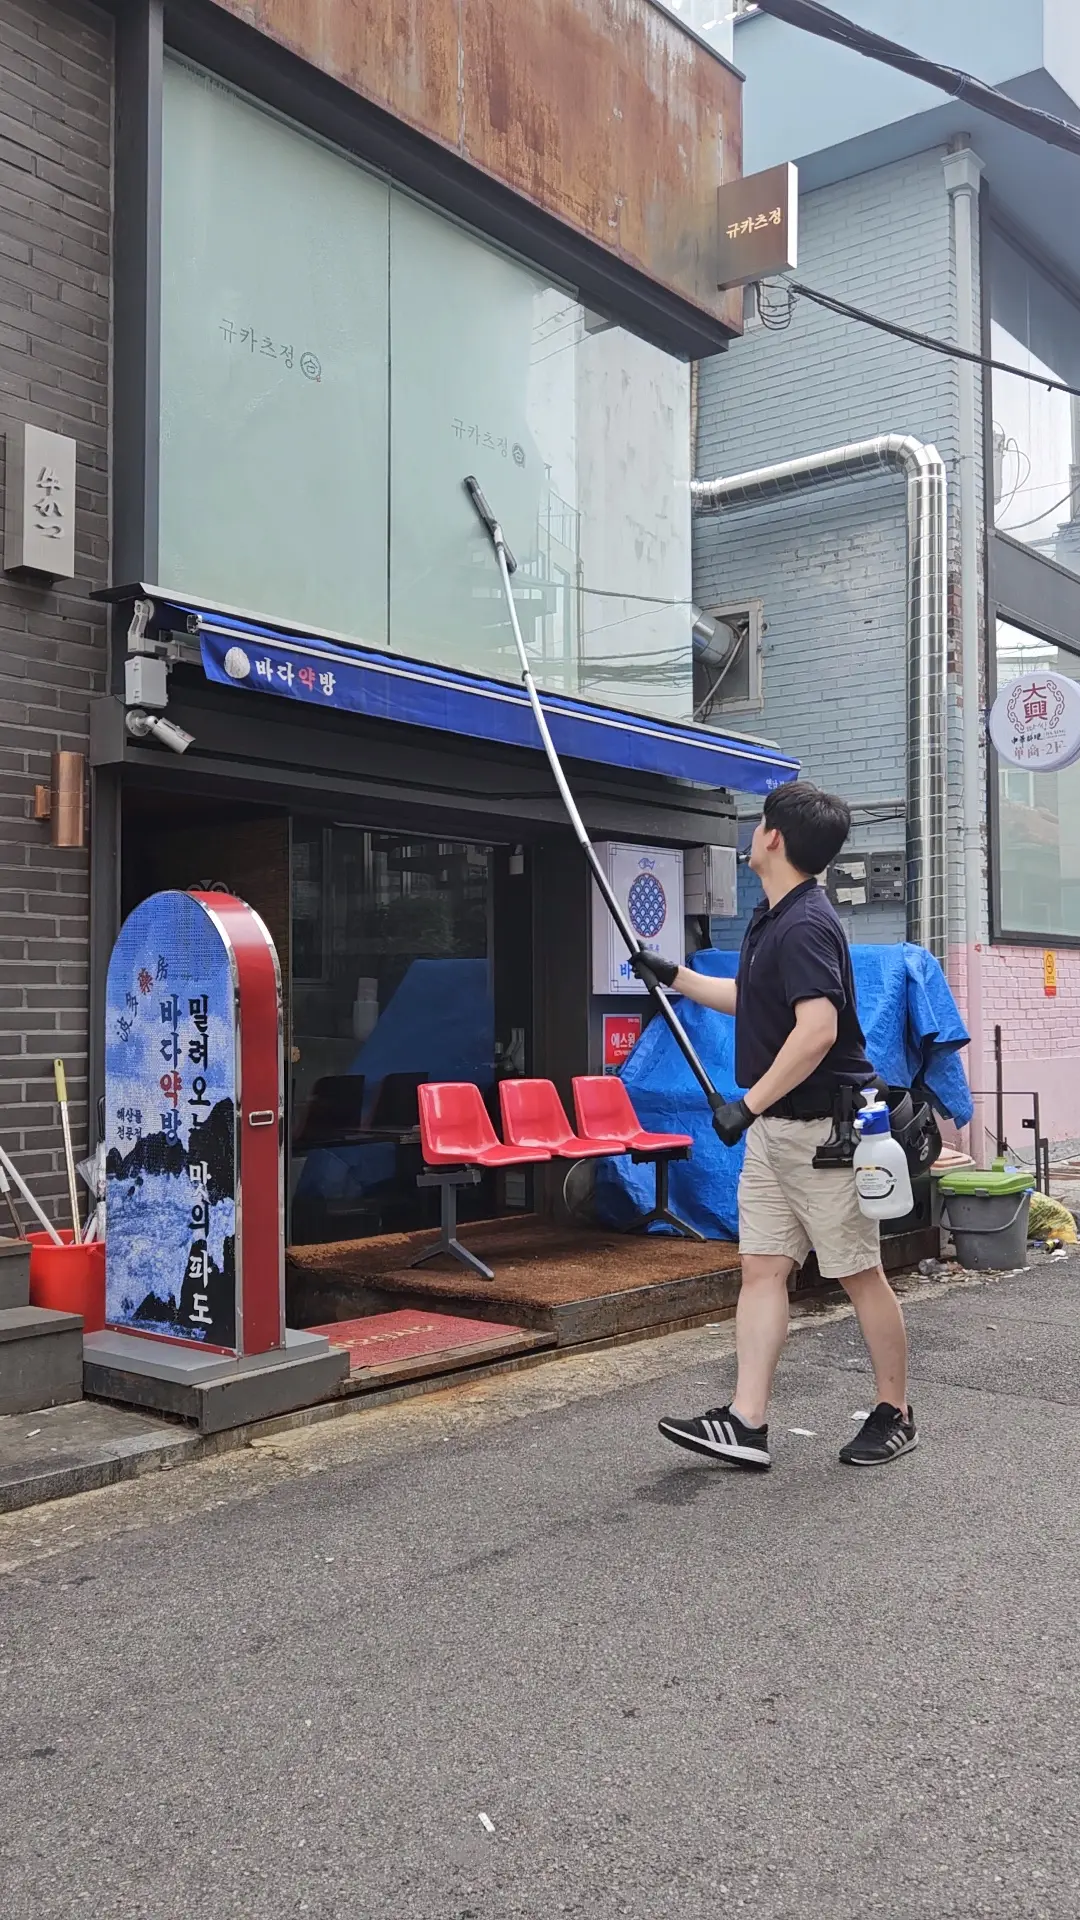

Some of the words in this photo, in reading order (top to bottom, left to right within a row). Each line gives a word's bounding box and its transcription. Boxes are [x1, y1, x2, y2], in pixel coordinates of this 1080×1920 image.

[726, 206, 782, 239] 규카츠정
[218, 318, 294, 369] 규카츠정
[450, 416, 508, 458] 규카츠정
[254, 656, 337, 696] 바다약방
[1022, 682, 1049, 724] 大興
[610, 1032, 636, 1048] 에스원
[159, 993, 183, 1145] 바다약방
[116, 1107, 143, 1124] 해산물
[188, 1160, 212, 1238] 맛의
[188, 1250, 213, 1325] 파도
